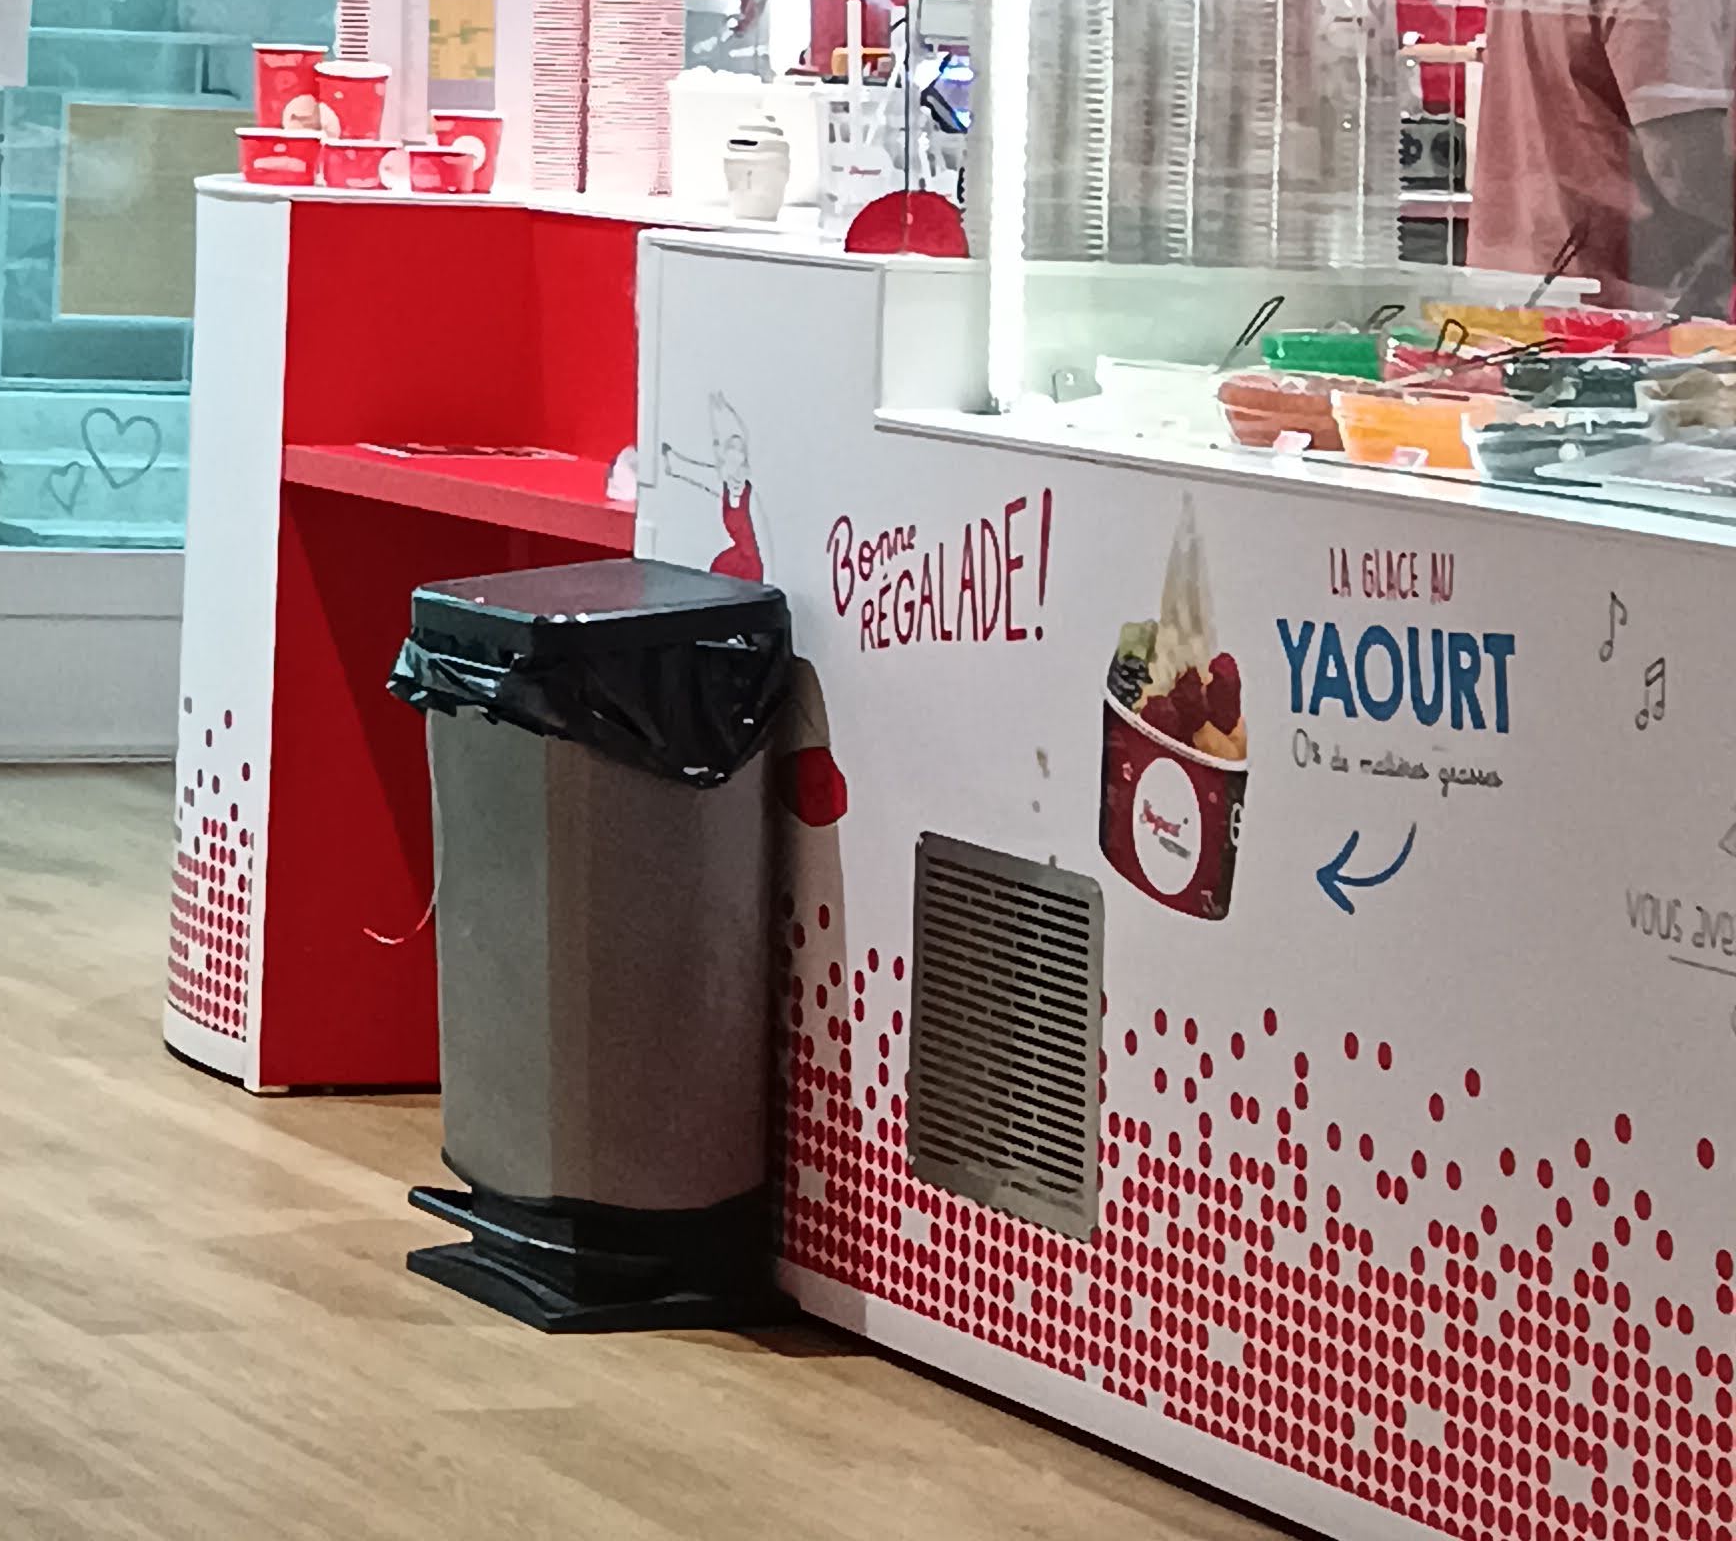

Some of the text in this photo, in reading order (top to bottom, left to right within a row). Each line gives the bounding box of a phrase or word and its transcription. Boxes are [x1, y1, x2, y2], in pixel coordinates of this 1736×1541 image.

[826, 515, 916, 617] Bonne
[861, 487, 1052, 652] RÉGALADE!
[1329, 547, 1454, 604] LA GLACE AU
[1276, 618, 1516, 733] YAOURT
